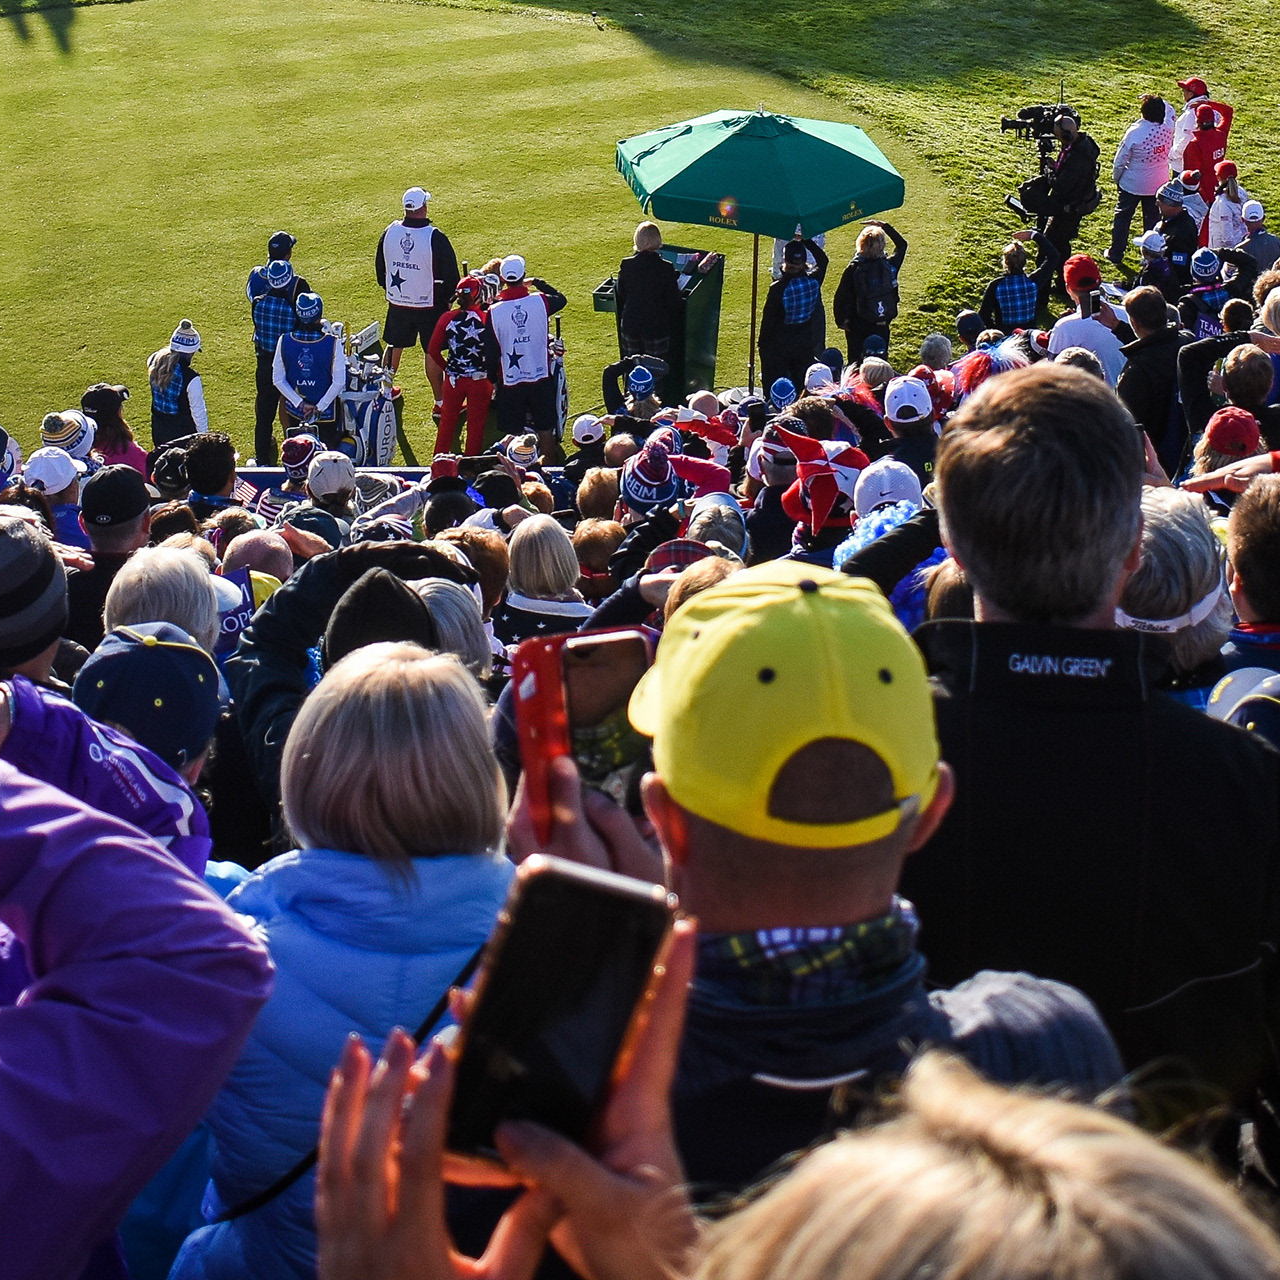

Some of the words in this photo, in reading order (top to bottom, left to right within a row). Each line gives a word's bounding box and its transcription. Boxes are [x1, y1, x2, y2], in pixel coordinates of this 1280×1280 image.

[1153, 144, 1166, 154] USA
[1213, 148, 1225, 160] USA
[842, 208, 864, 220] ROLEX
[709, 216, 738, 226] ROLEX
[392, 261, 420, 271] PRESSEL
[296, 379, 316, 387] LAW
[630, 383, 646, 392] CUP
[380, 404, 393, 466] EUROPE
[626, 474, 657, 500] HEIM
[1008, 653, 1058, 675] GALVIN
